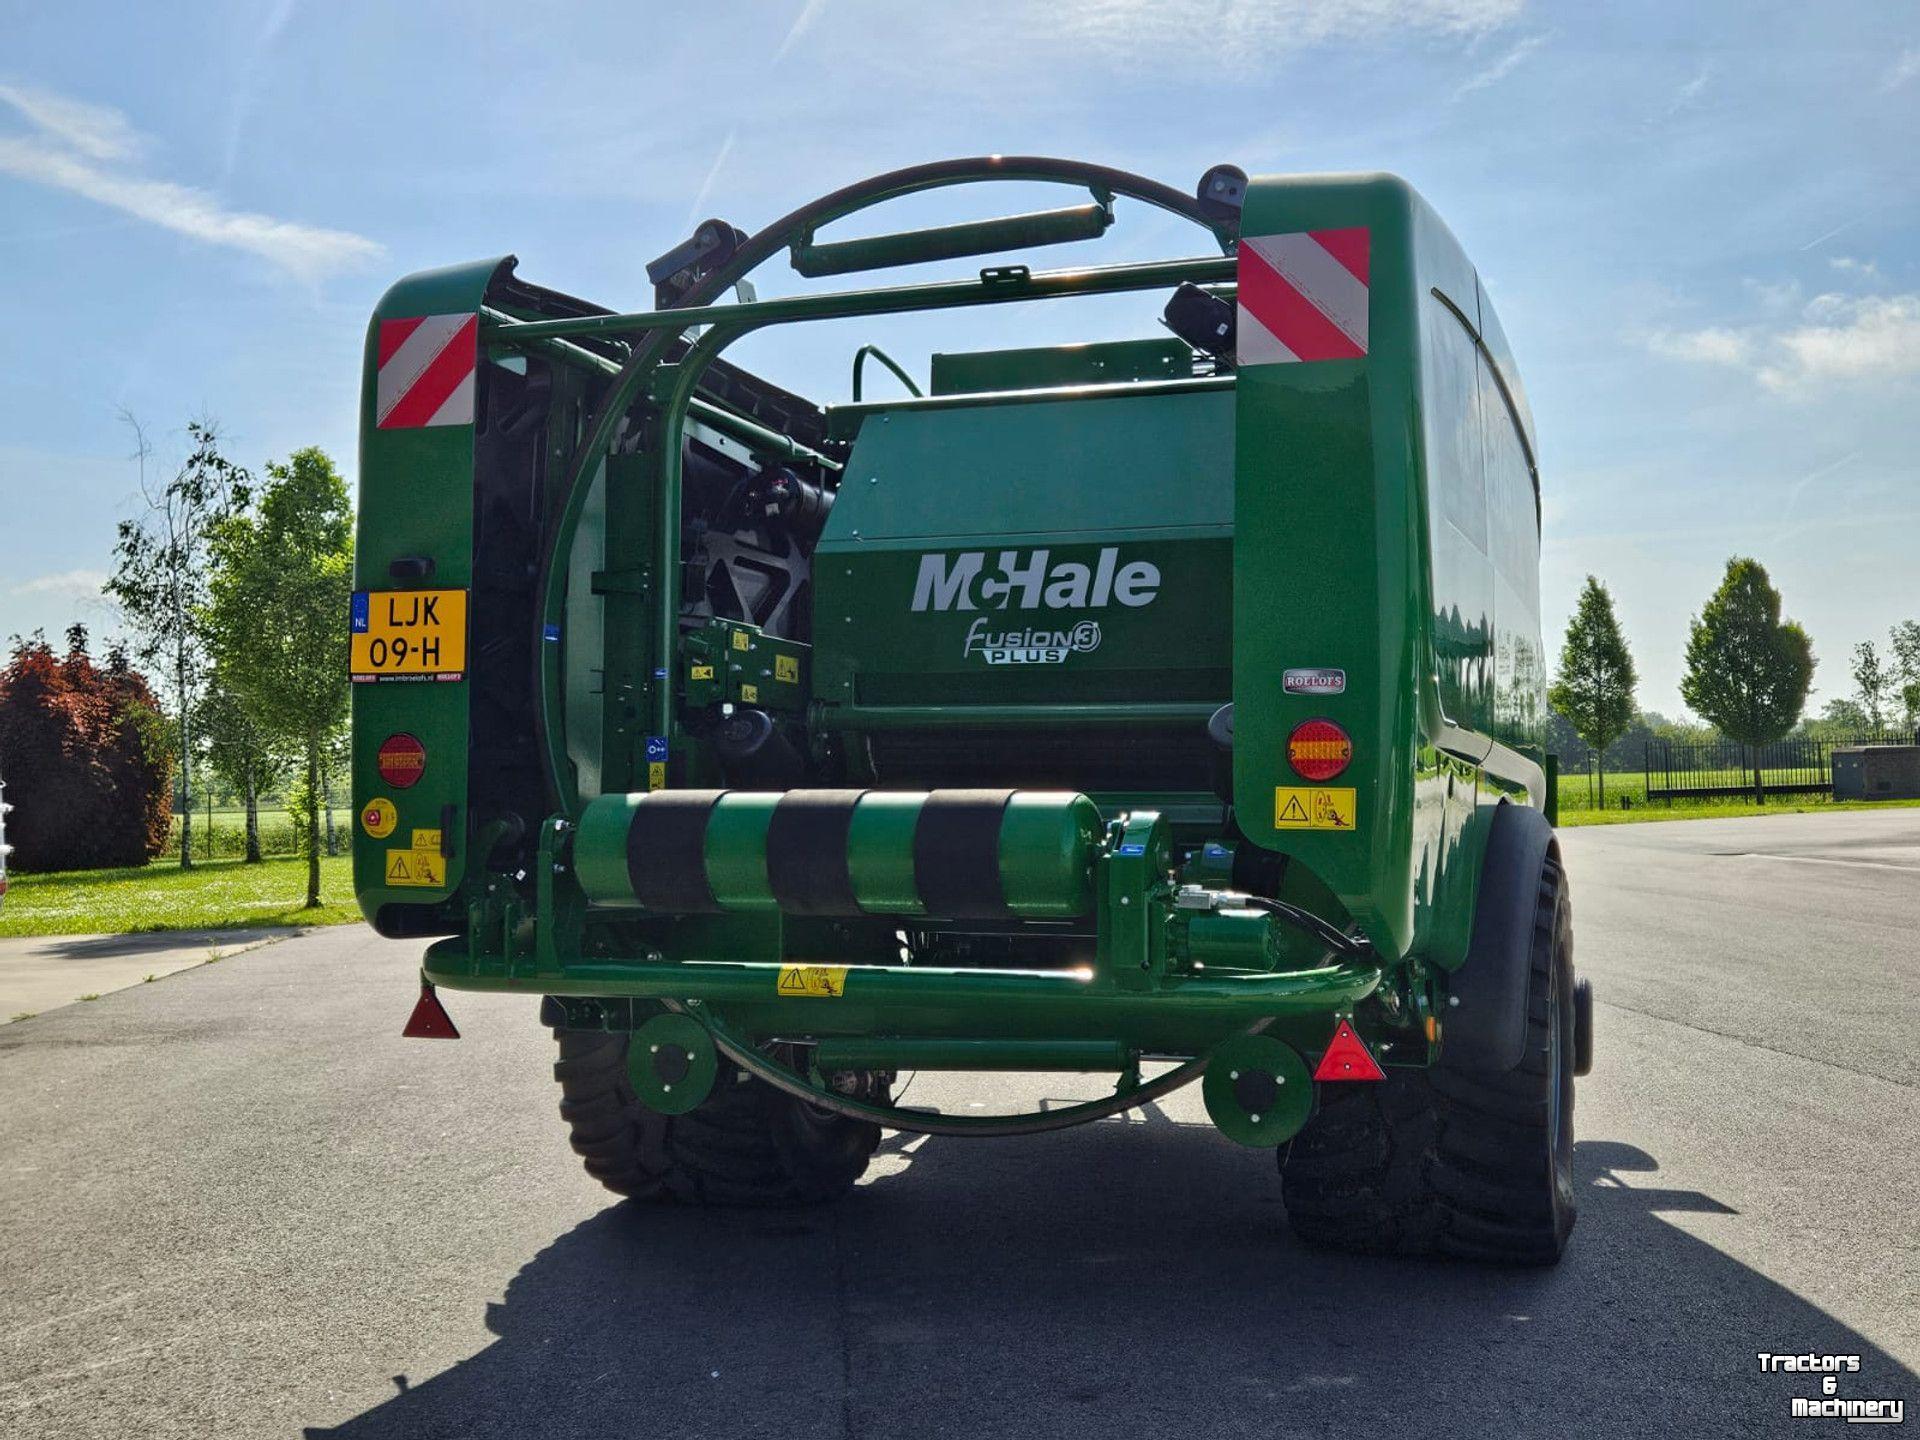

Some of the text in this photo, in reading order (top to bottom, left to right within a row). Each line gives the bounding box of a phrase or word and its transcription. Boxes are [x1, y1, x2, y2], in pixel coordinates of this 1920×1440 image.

[911, 547, 1161, 611] McHale
[355, 617, 366, 628] NL
[389, 596, 440, 627] LJK
[370, 637, 440, 668] 09-H
[991, 650, 1060, 663] PLUS
[1287, 676, 1343, 687] ROELOFS
